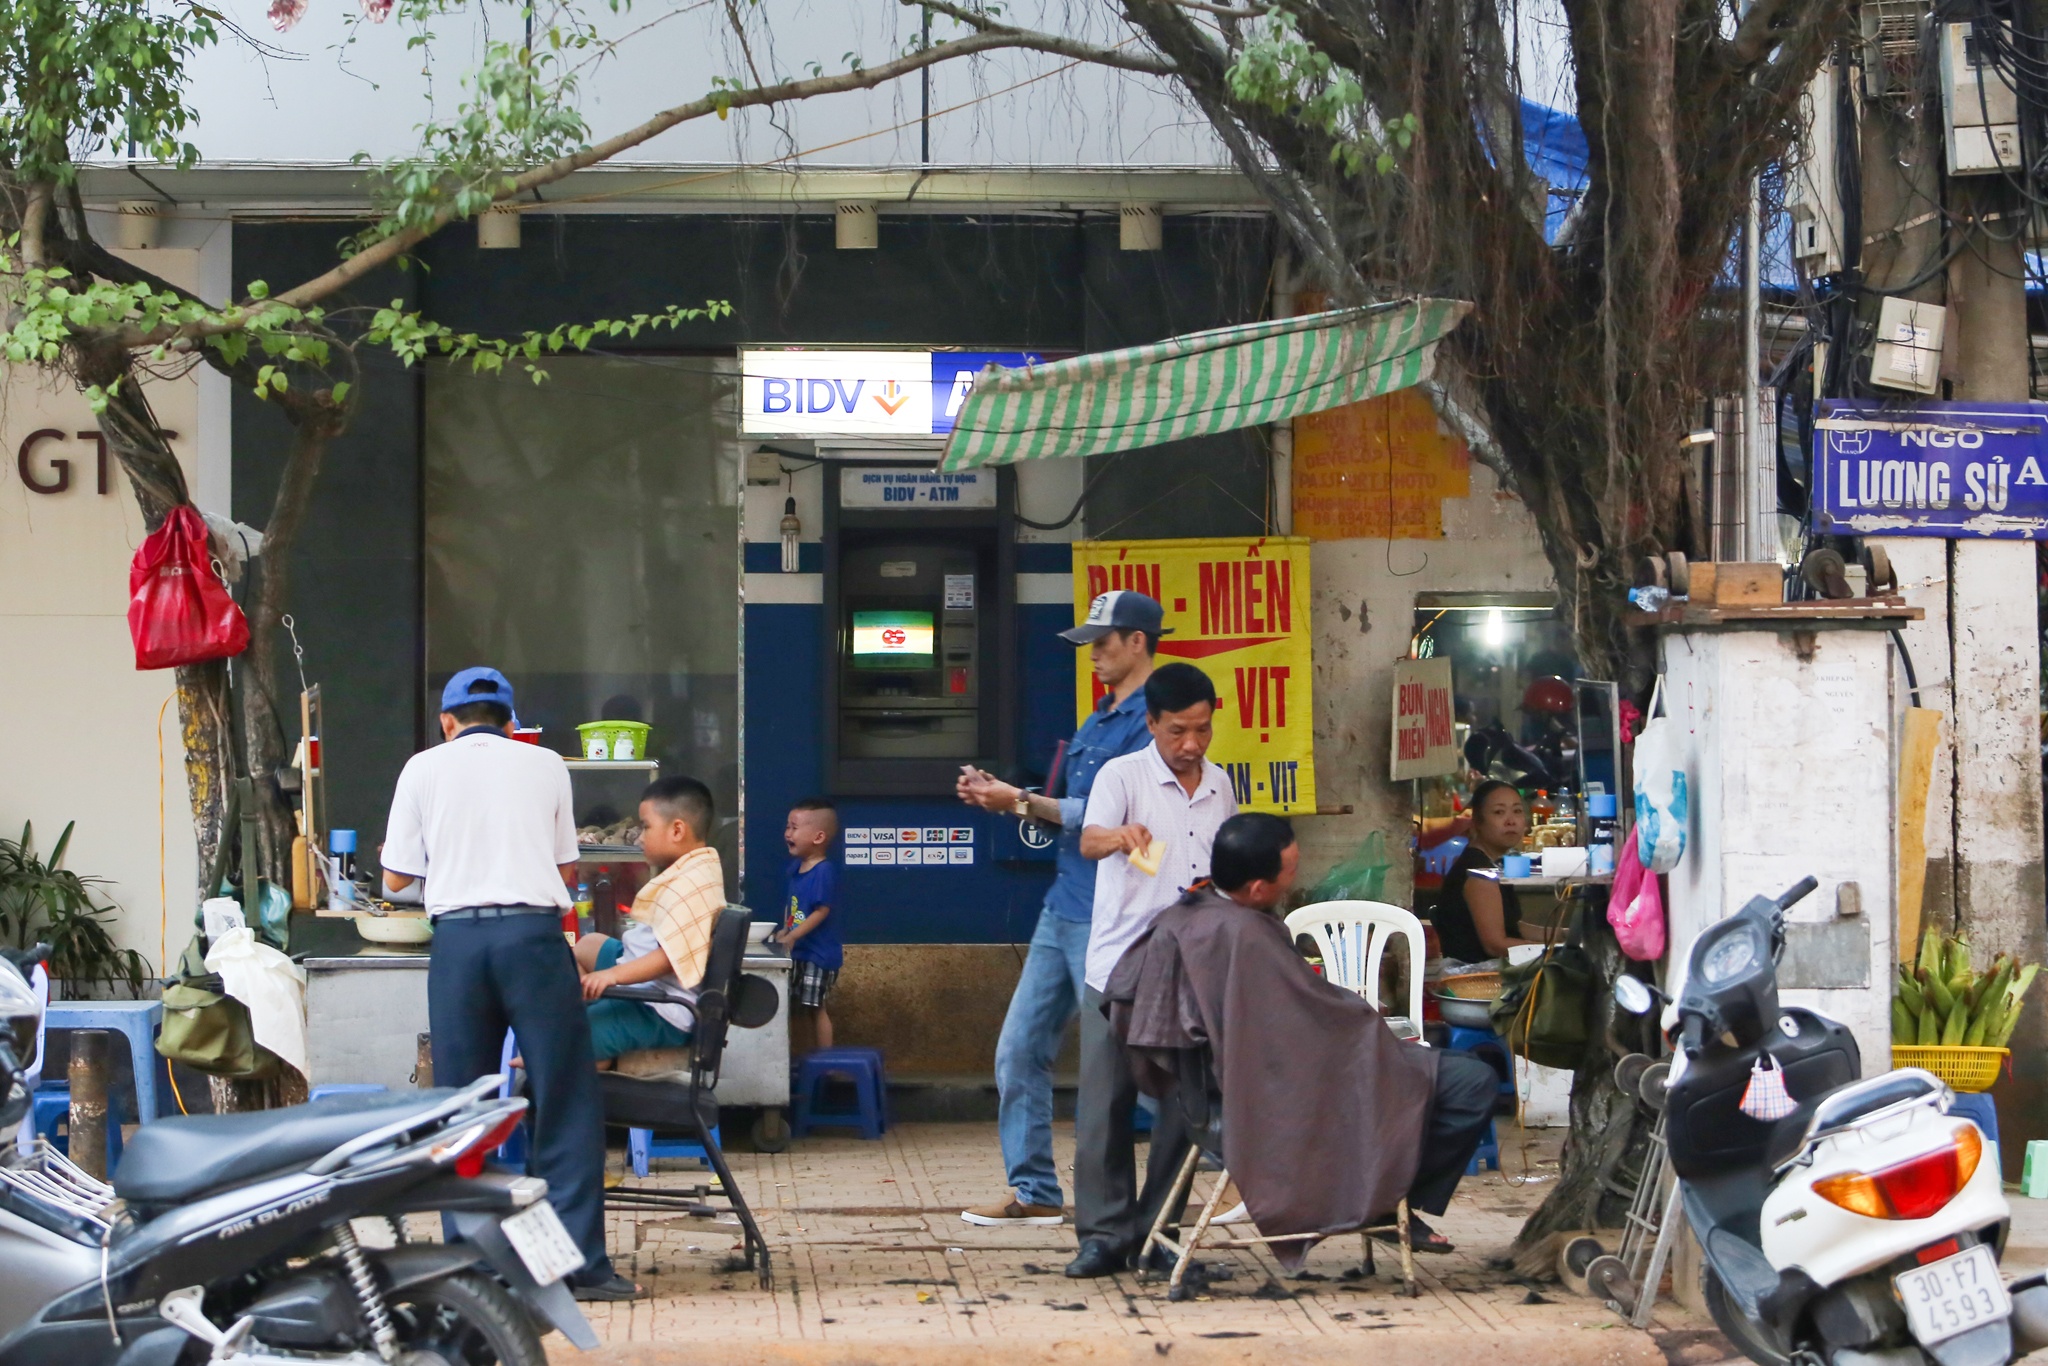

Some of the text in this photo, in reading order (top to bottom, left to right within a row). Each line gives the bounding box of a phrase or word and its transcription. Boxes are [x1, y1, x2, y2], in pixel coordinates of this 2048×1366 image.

[763, 379, 865, 414] BIDV
[883, 487, 916, 502] BIDV
[928, 487, 959, 502] ATM
[1839, 459, 1951, 510] LƯƠNG
[1964, 455, 2011, 512] SỬ
[1199, 538, 1292, 635] MIẾN
[1235, 665, 1291, 743] VỊT
[1399, 676, 1424, 717] BÚN
[1398, 718, 1425, 761] MIẾN
[1269, 761, 1298, 812] VỊT
[873, 832, 895, 840] VISA
[218, 1189, 331, 1240] AIR BLADE
[1929, 1287, 1995, 1333] 4593
